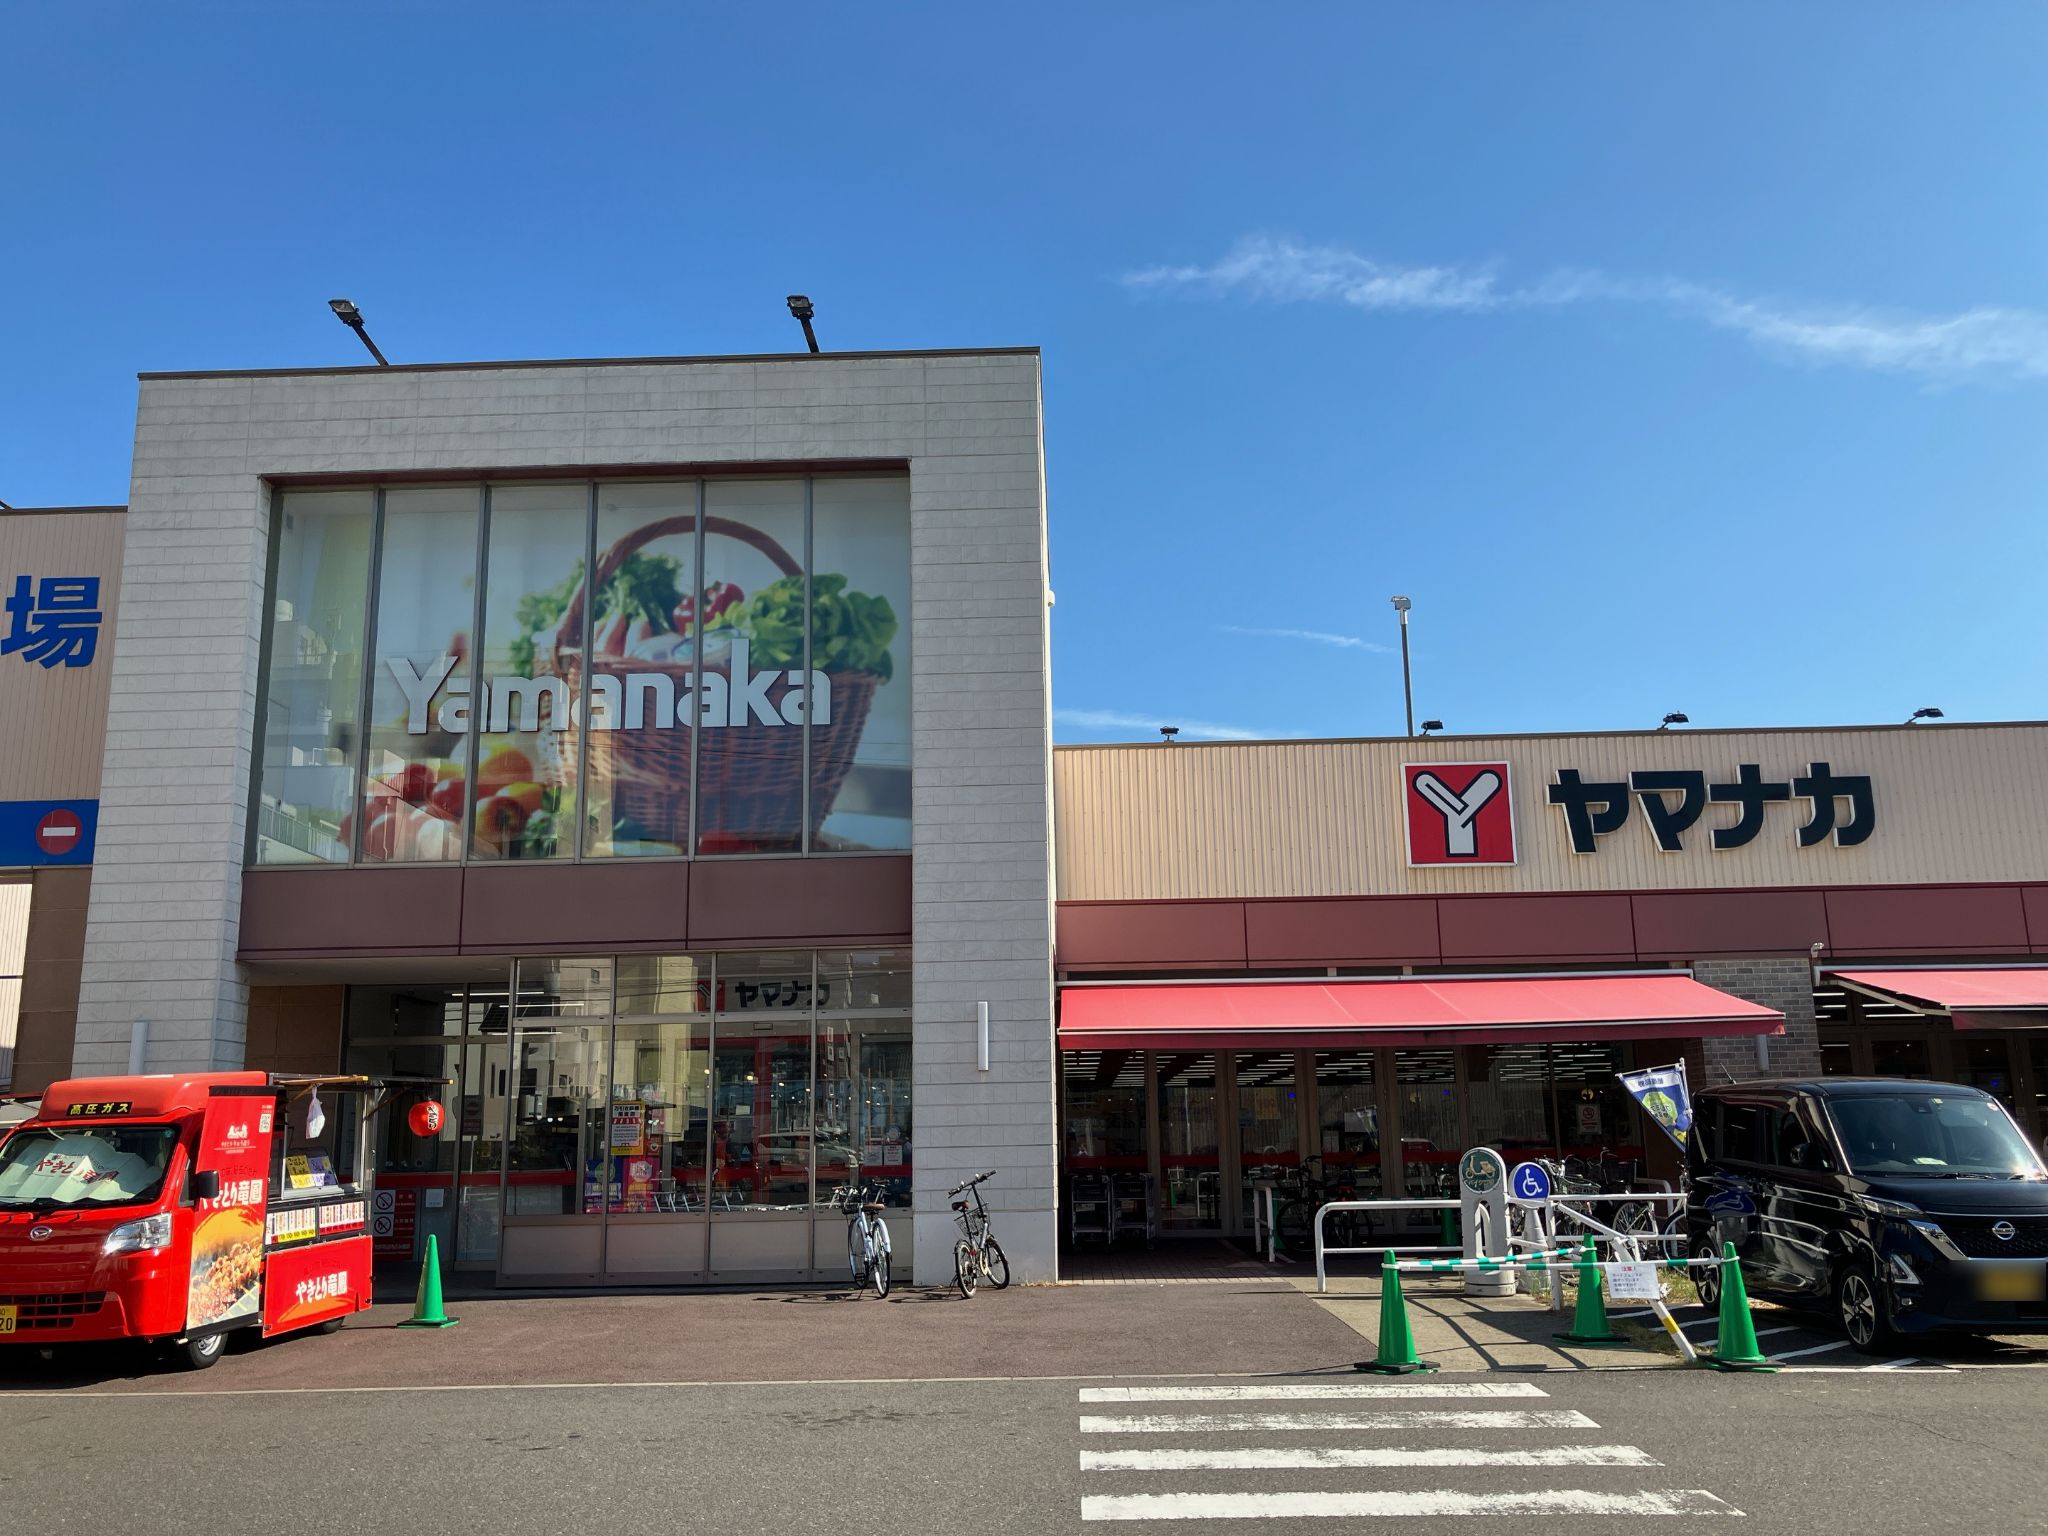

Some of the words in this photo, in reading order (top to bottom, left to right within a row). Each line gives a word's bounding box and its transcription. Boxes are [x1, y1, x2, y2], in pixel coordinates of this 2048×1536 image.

[1, 575, 103, 669] 場
[385, 638, 831, 734] Yamanaka
[1546, 761, 1876, 855] ヤマナカ
[735, 980, 830, 1008] ヤマナカ
[70, 1102, 129, 1115] 高圧ガス
